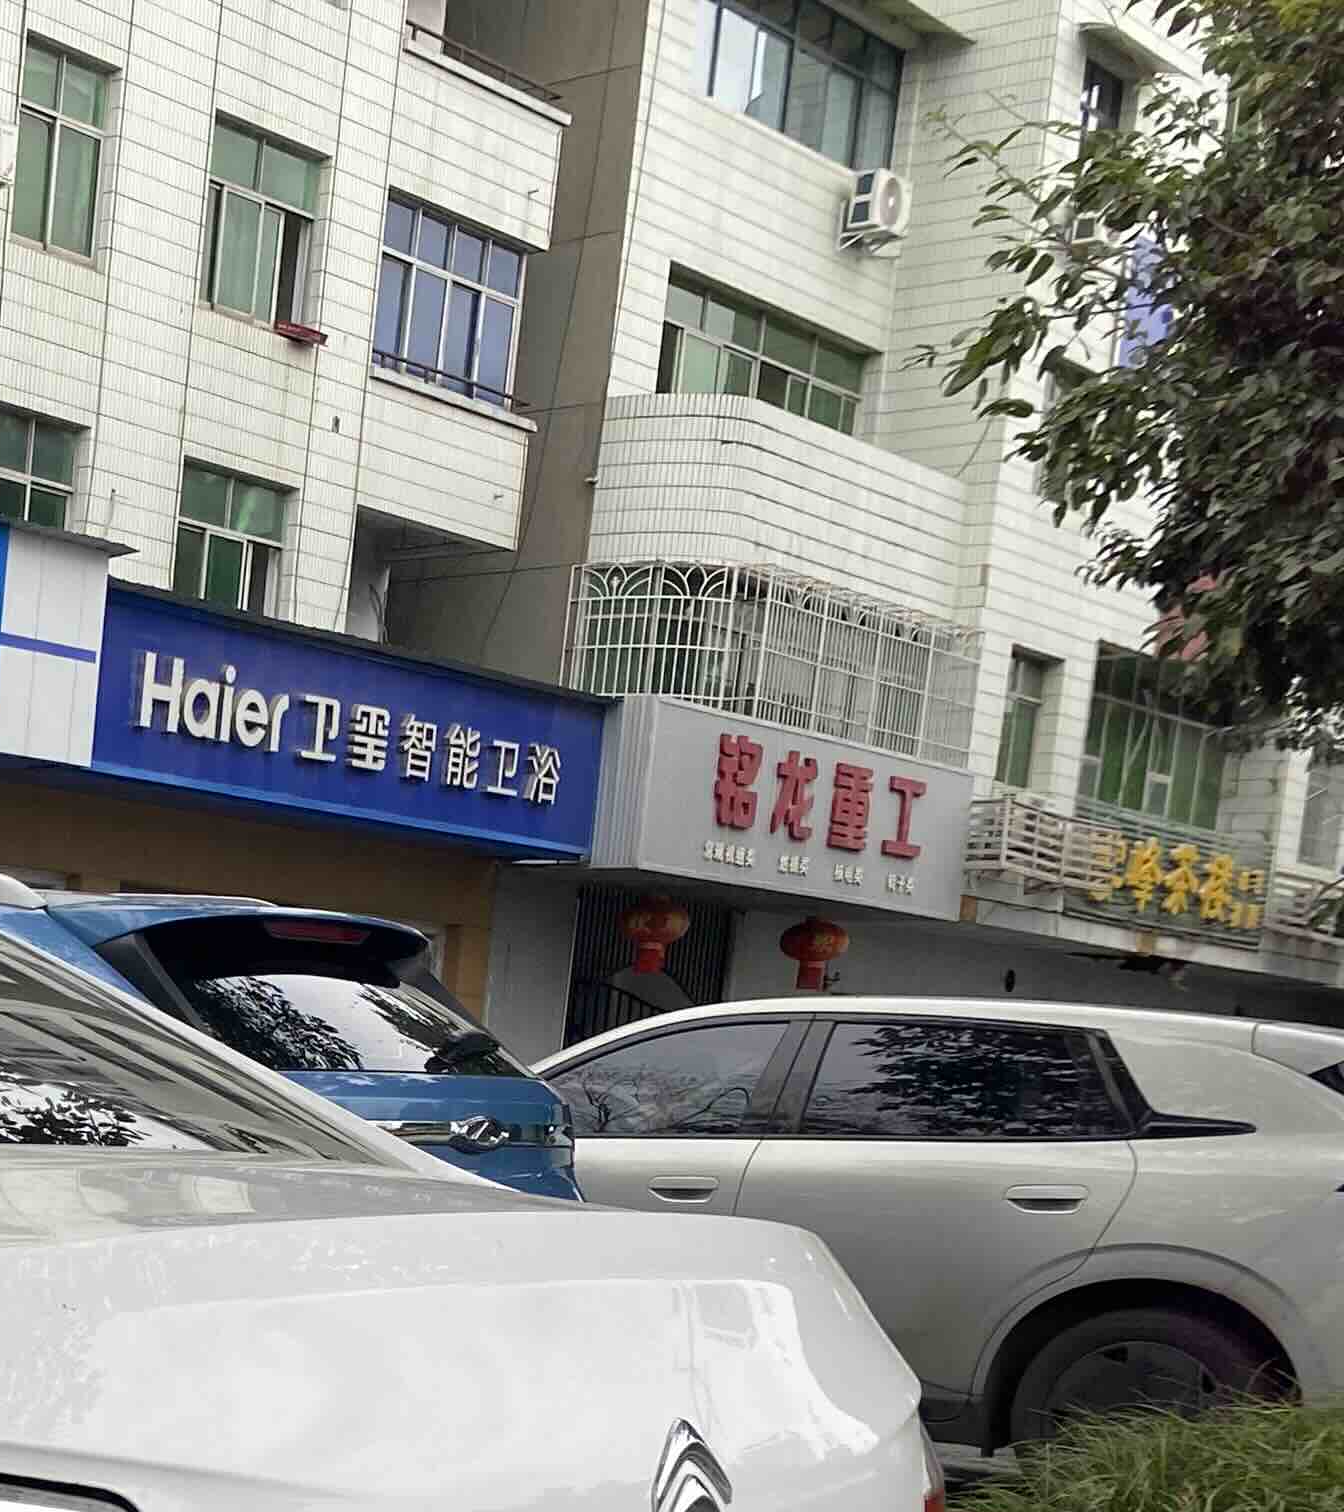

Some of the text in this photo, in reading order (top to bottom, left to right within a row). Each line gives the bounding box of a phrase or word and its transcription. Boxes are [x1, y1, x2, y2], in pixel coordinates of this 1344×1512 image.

[138, 650, 562, 806] Haier 卫玺智能卫浴
[714, 733, 929, 860] 铭龙重工
